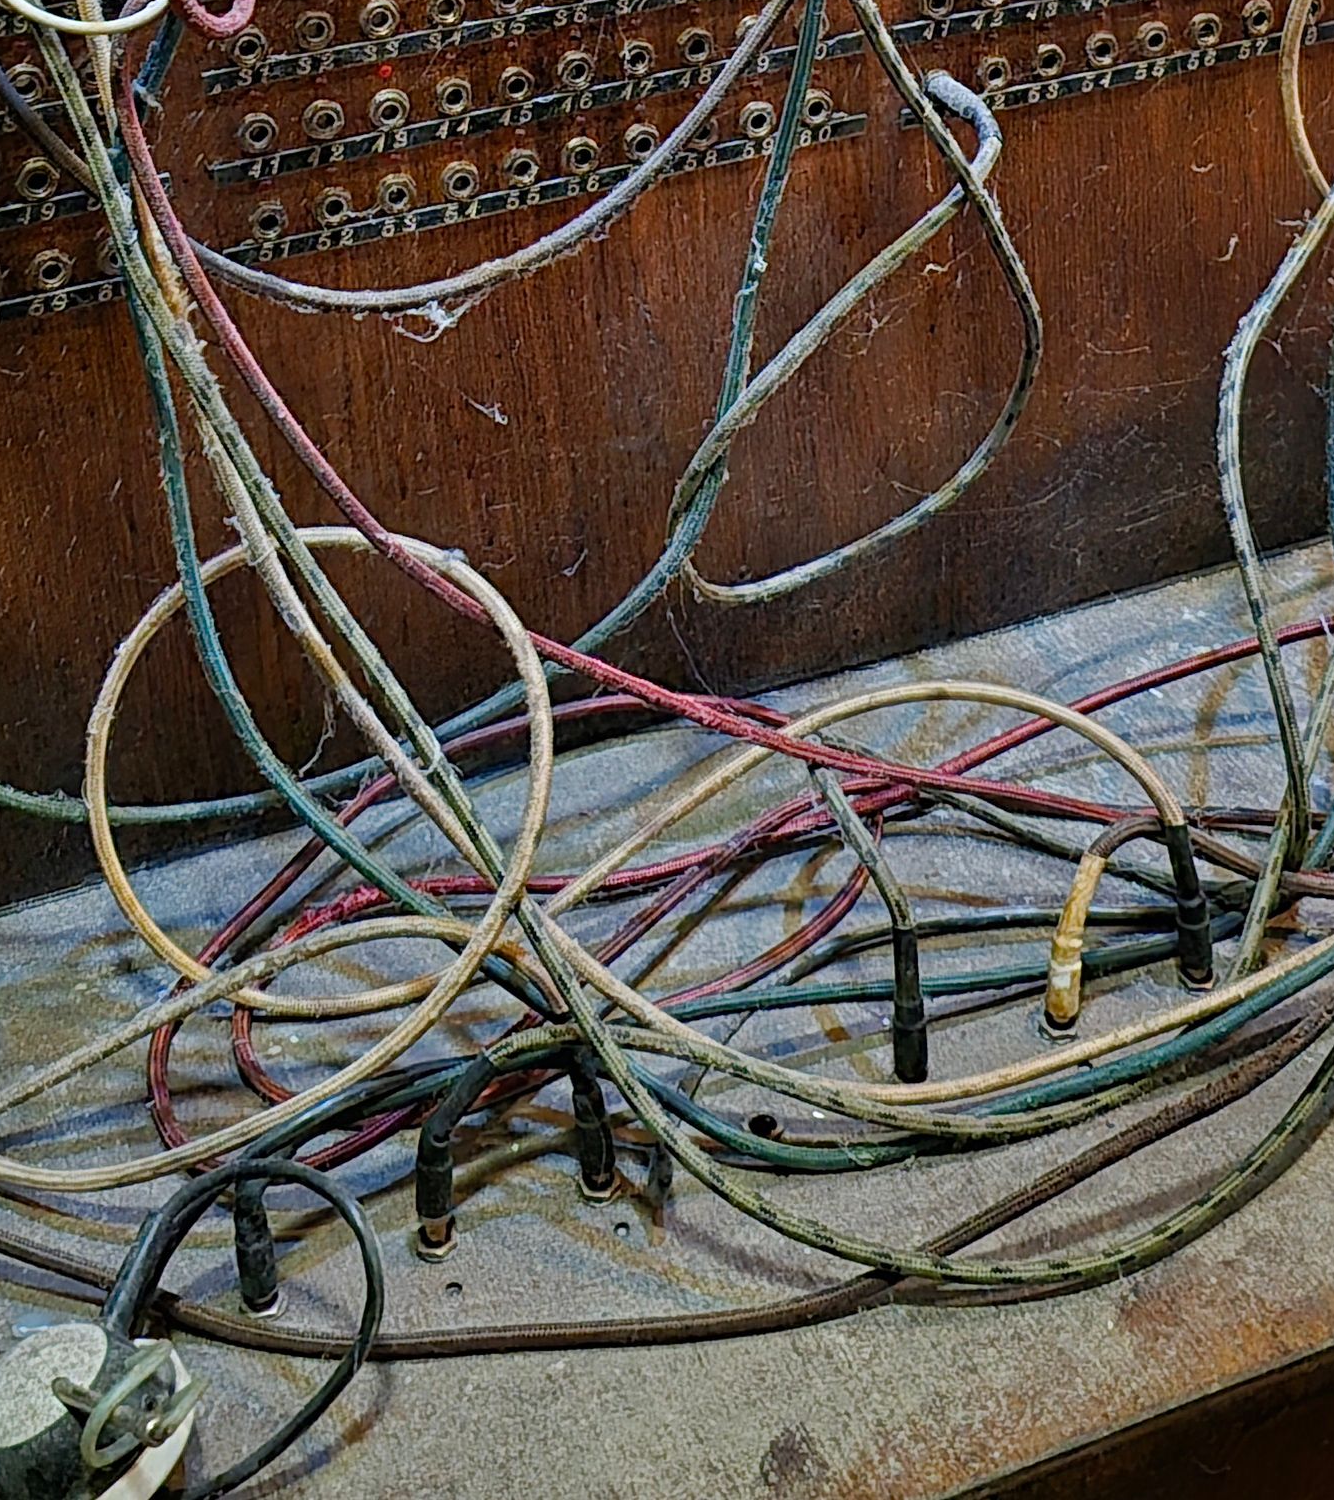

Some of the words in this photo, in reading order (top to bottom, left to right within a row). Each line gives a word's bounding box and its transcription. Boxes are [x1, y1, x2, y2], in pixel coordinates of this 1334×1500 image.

[260, 238, 289, 261] 51
[318, 228, 354, 249] 52
[567, 176, 600, 196] 56
[684, 151, 717, 170] 58
[743, 138, 773, 158] 59
[800, 126, 831, 146] 60
[29, 293, 67, 317] 59
